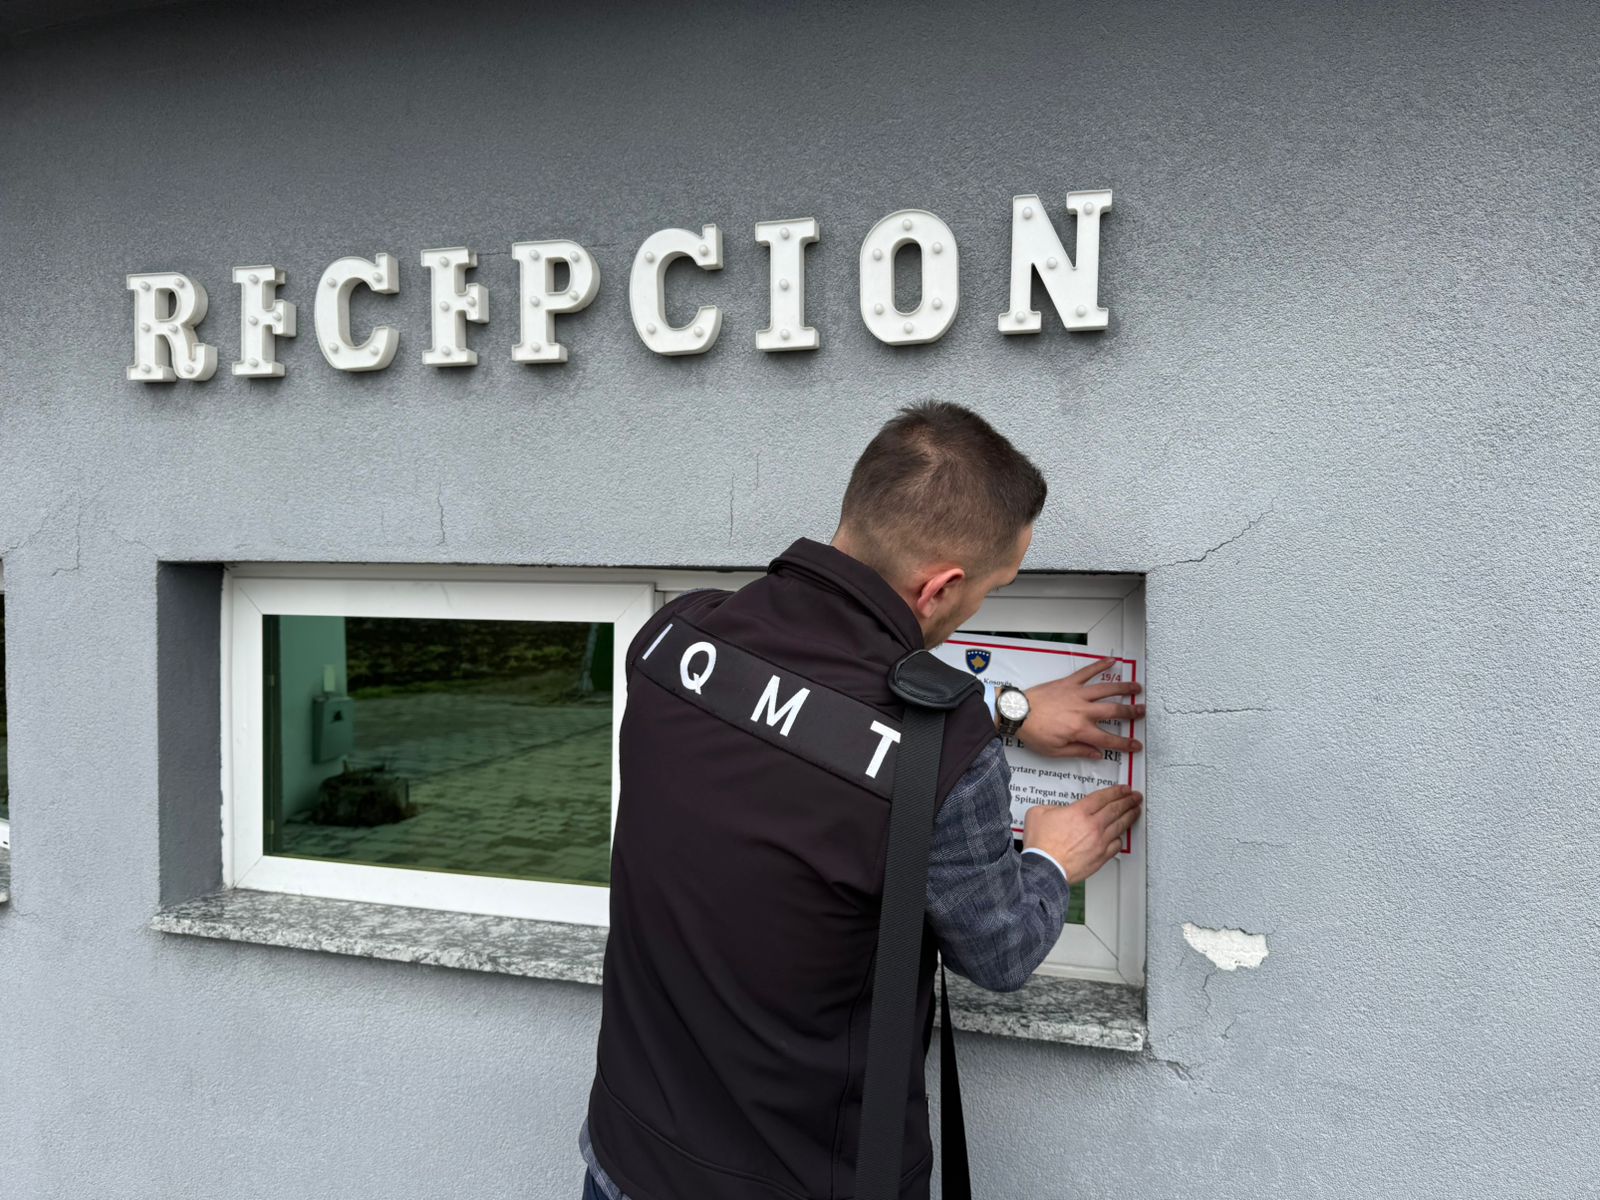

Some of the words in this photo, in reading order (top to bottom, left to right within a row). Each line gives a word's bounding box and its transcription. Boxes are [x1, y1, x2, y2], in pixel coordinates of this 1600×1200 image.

[1038, 768, 1071, 781] paraqet
[1072, 774, 1095, 784] vepër
[1029, 785, 1057, 798] Tregut
[1058, 791, 1069, 799] në
[1015, 794, 1045, 806] Spitalit
